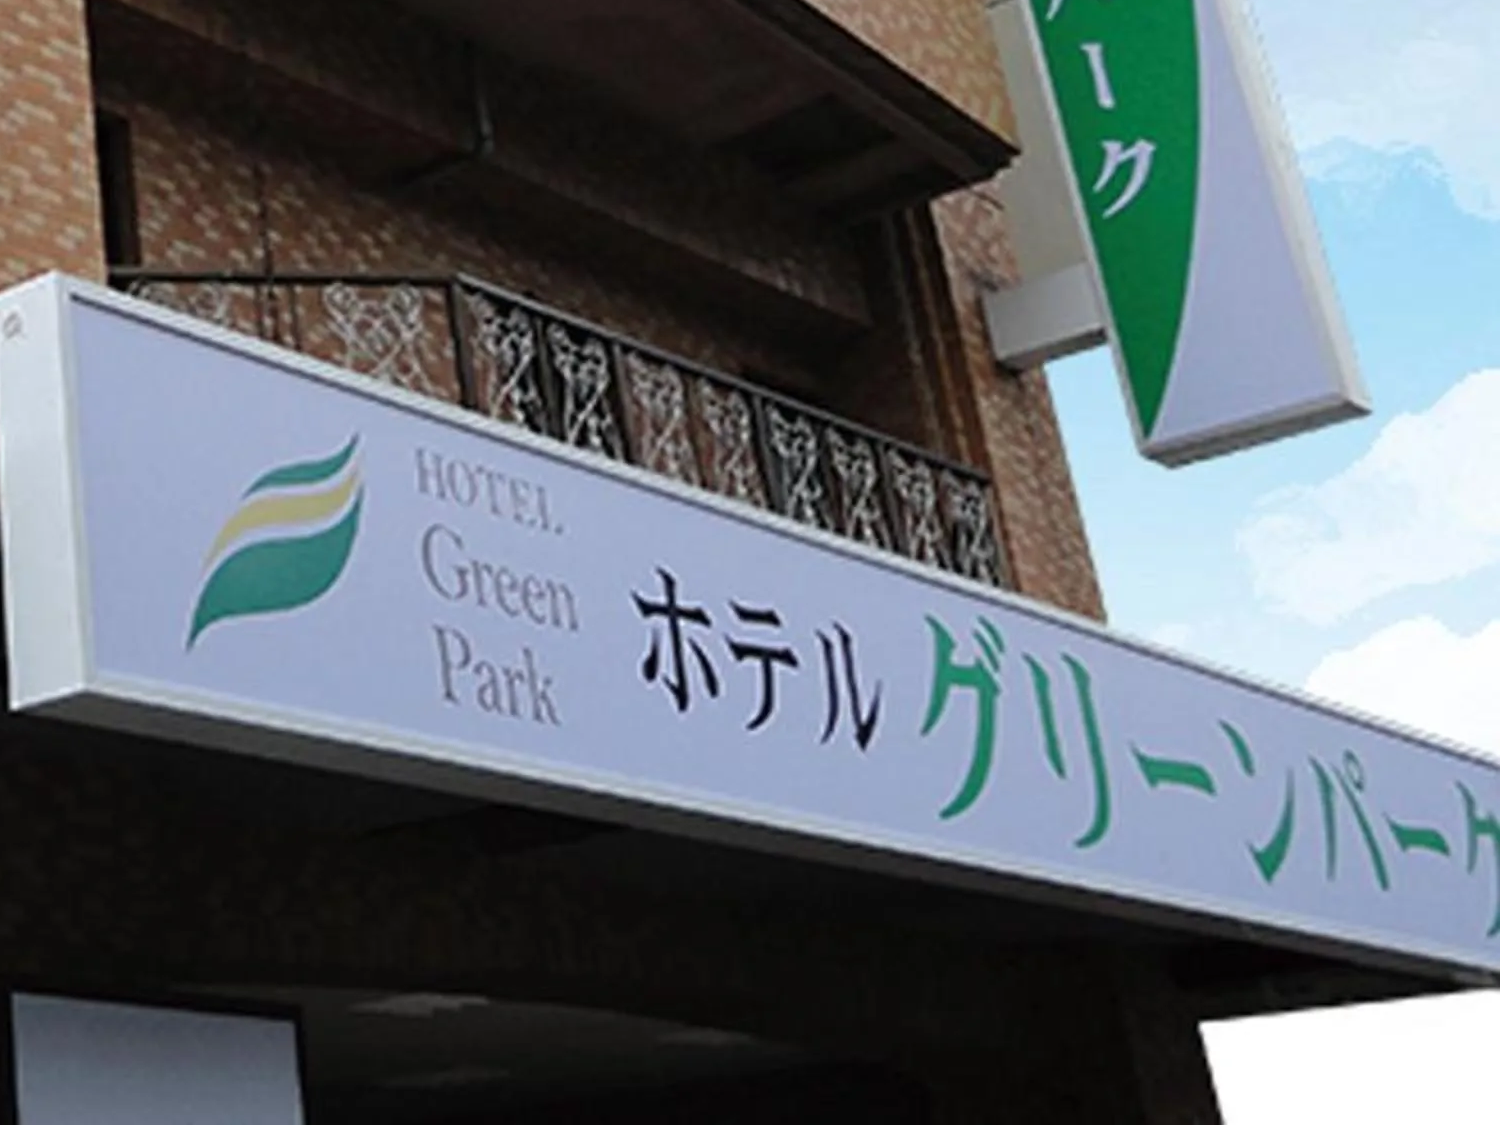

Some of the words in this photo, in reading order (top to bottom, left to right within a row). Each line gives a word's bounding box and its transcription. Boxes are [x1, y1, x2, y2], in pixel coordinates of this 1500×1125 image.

[415, 448, 564, 535] HOTEL
[421, 523, 579, 632] Green
[432, 625, 562, 725] Park
[631, 565, 883, 752] ホテル
